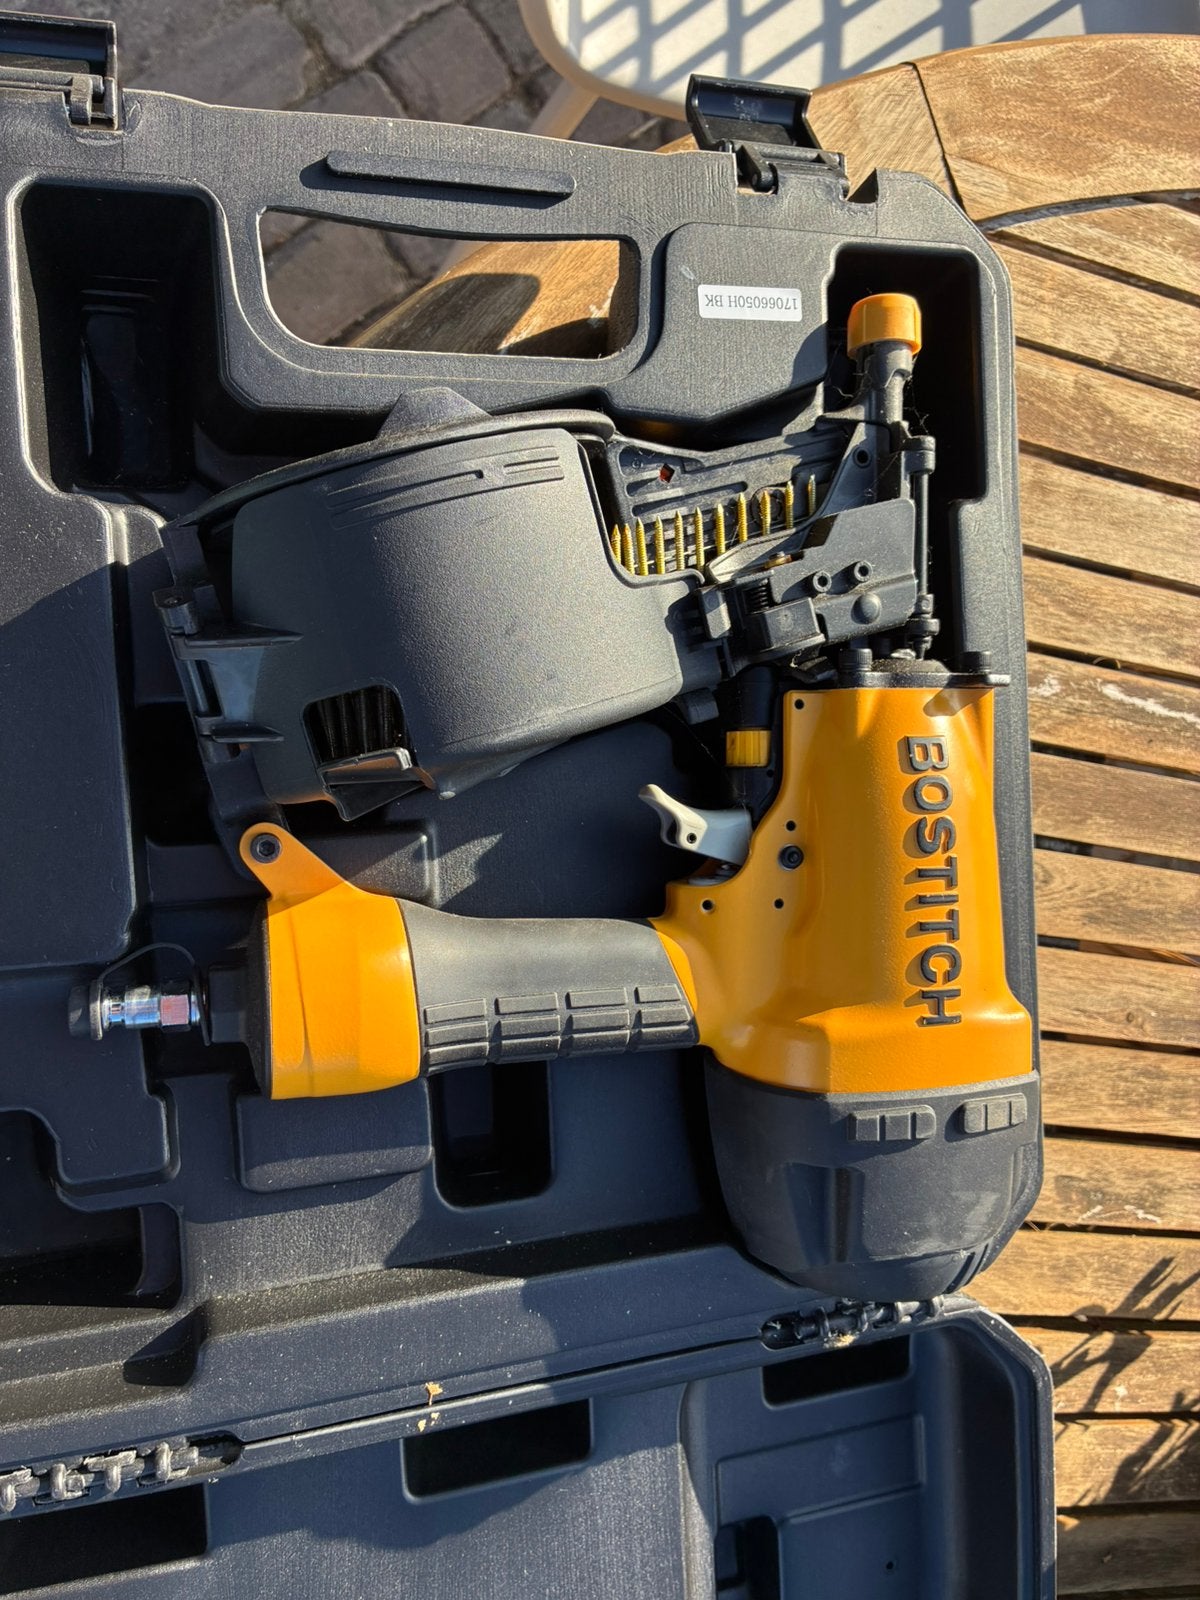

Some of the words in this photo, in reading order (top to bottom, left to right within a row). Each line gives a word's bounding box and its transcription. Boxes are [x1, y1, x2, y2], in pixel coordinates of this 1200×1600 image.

[704, 294, 723, 307] BK
[728, 295, 798, 310] 17066050H
[906, 735, 962, 1026] BOSTITCH
